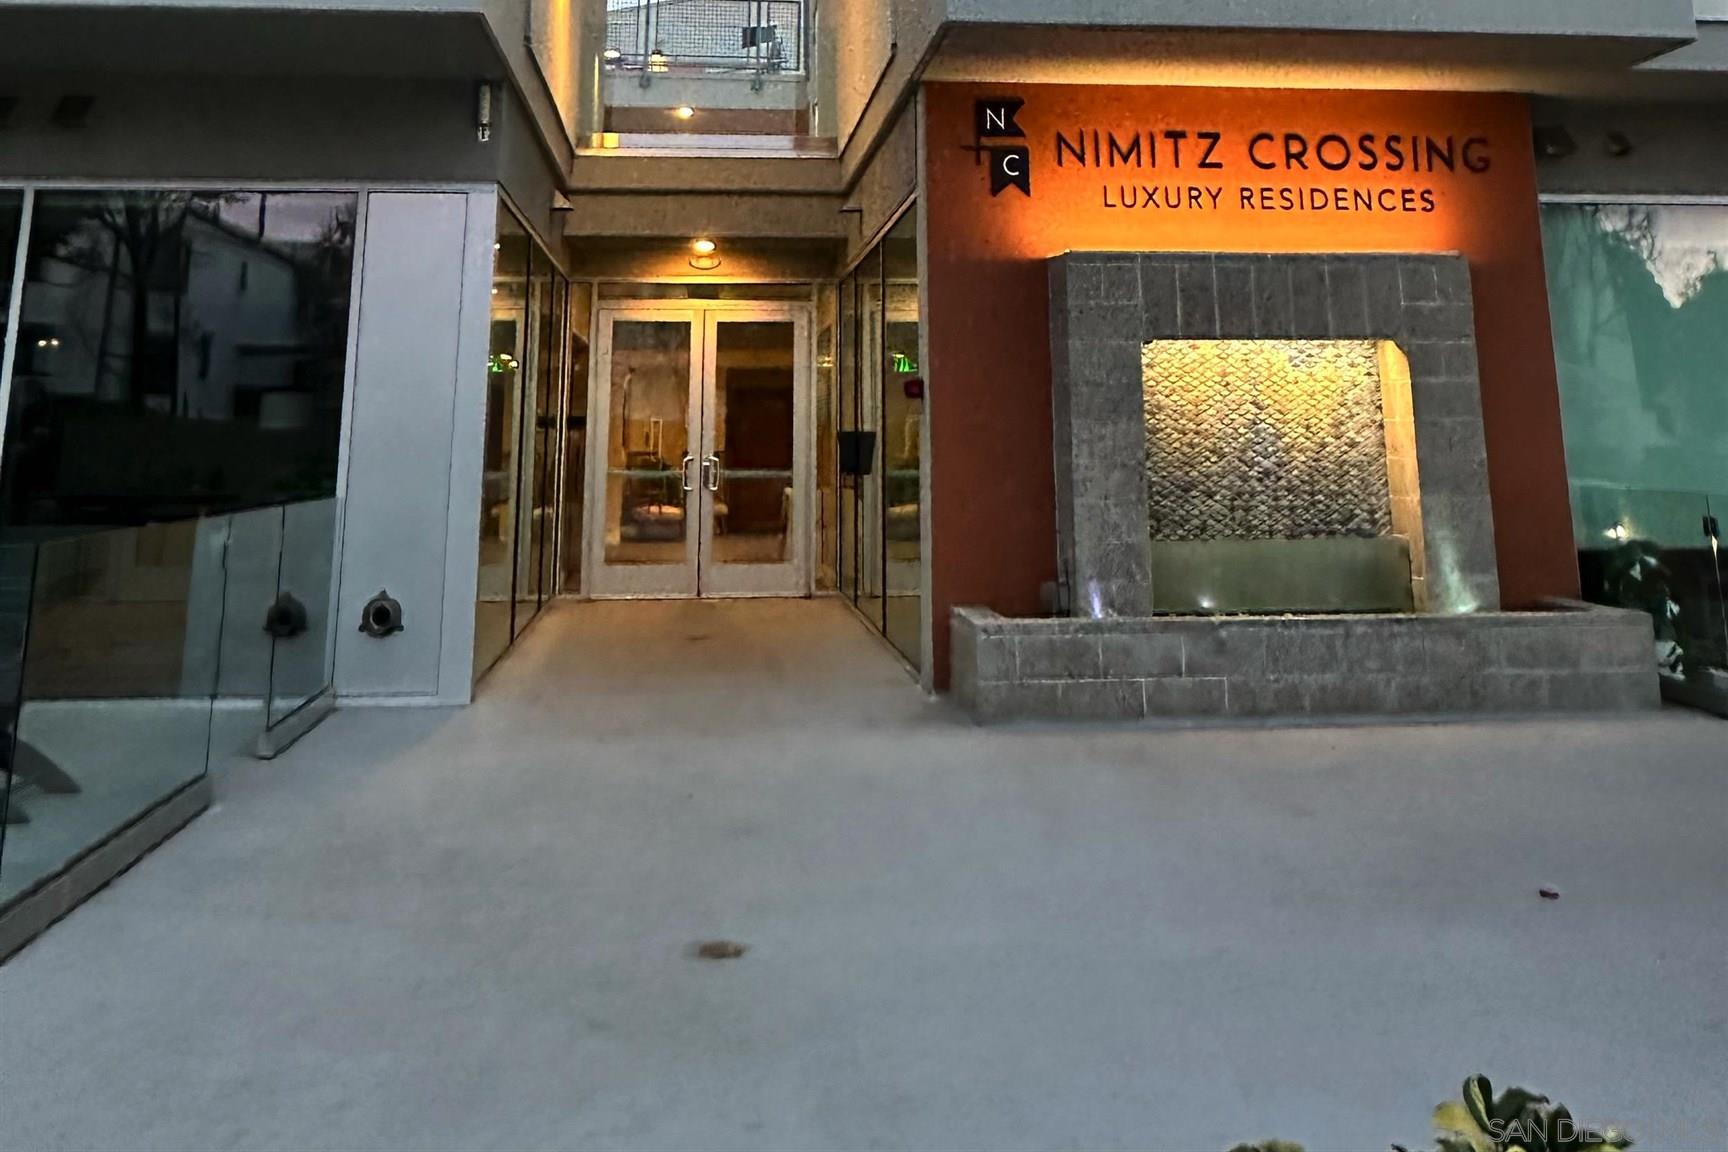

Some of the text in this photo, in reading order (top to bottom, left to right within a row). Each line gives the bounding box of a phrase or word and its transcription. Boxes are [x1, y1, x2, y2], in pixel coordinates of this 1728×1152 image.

[985, 108, 1006, 130] N
[1056, 129, 1492, 173] NIMITZ CROSSING
[1002, 154, 1021, 176] C
[1102, 185, 1436, 212] LUXURY RESIDENCES
